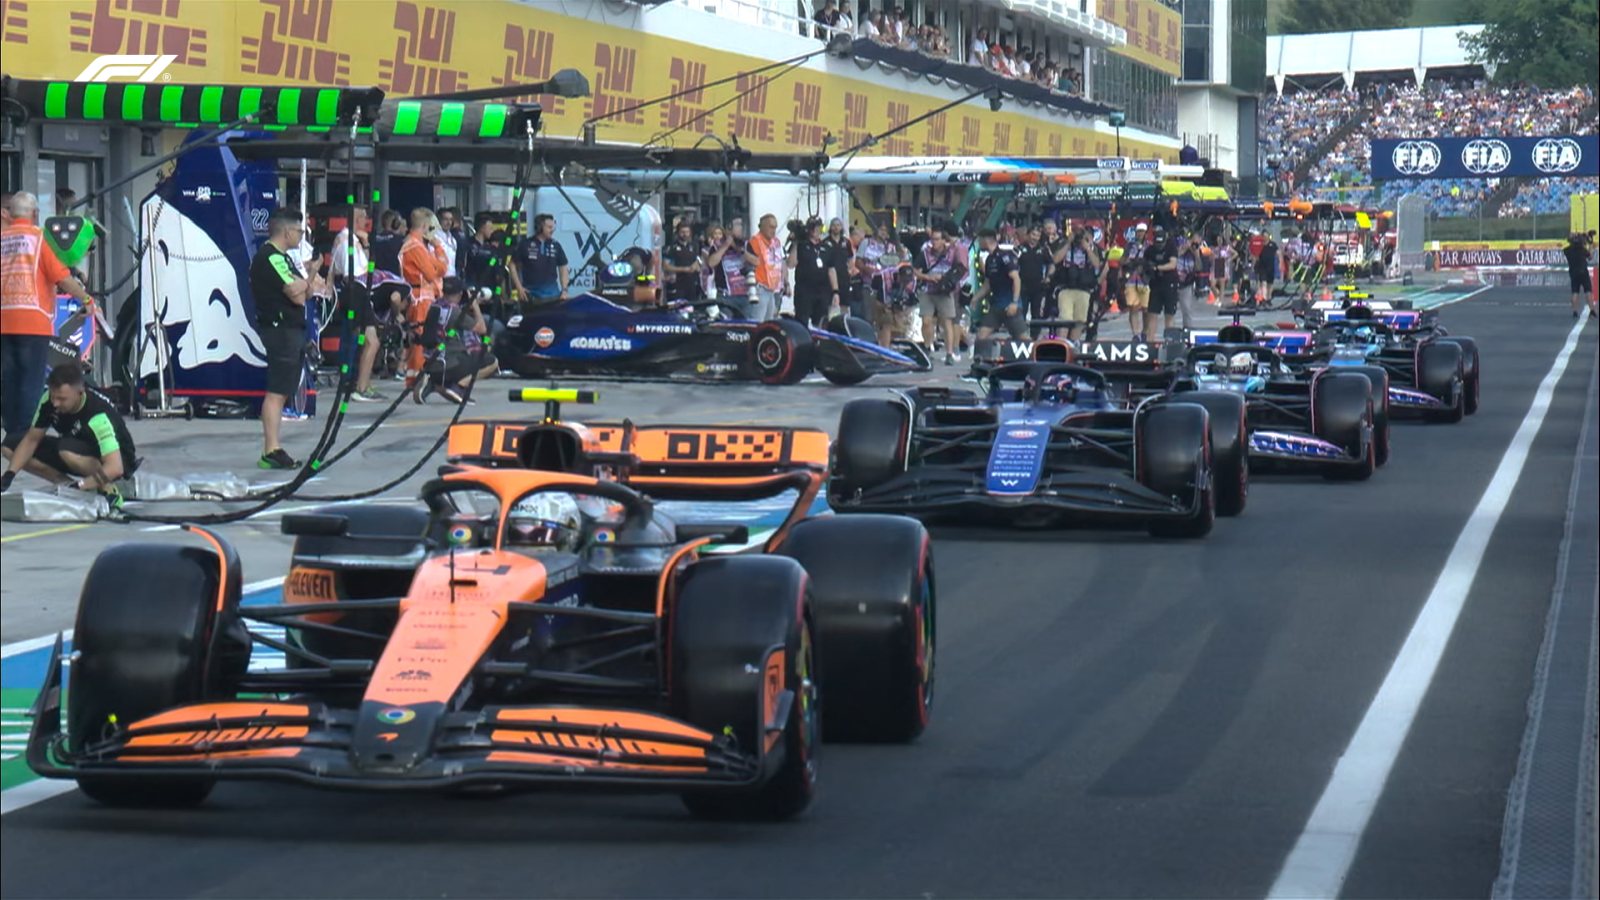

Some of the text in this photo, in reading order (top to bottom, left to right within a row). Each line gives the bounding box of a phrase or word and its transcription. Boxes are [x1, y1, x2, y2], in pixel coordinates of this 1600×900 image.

[256, 0, 338, 85] DHL
[391, 1, 458, 96] DHL
[592, 43, 638, 124] DHL
[667, 57, 708, 133] DHL
[734, 71, 770, 142] DHL
[791, 82, 823, 147] DHL
[842, 92, 869, 153] DHL
[957, 173, 982, 183] Gulf
[250, 208, 270, 230] 22
[1461, 250, 1502, 265] AIRWAYS
[1516, 250, 1545, 265] QATAR
[569, 335, 632, 351] KOMATSU
[635, 324, 693, 335] MYPROTEIN
[725, 331, 751, 343] Steph
[667, 432, 775, 461] OKX
